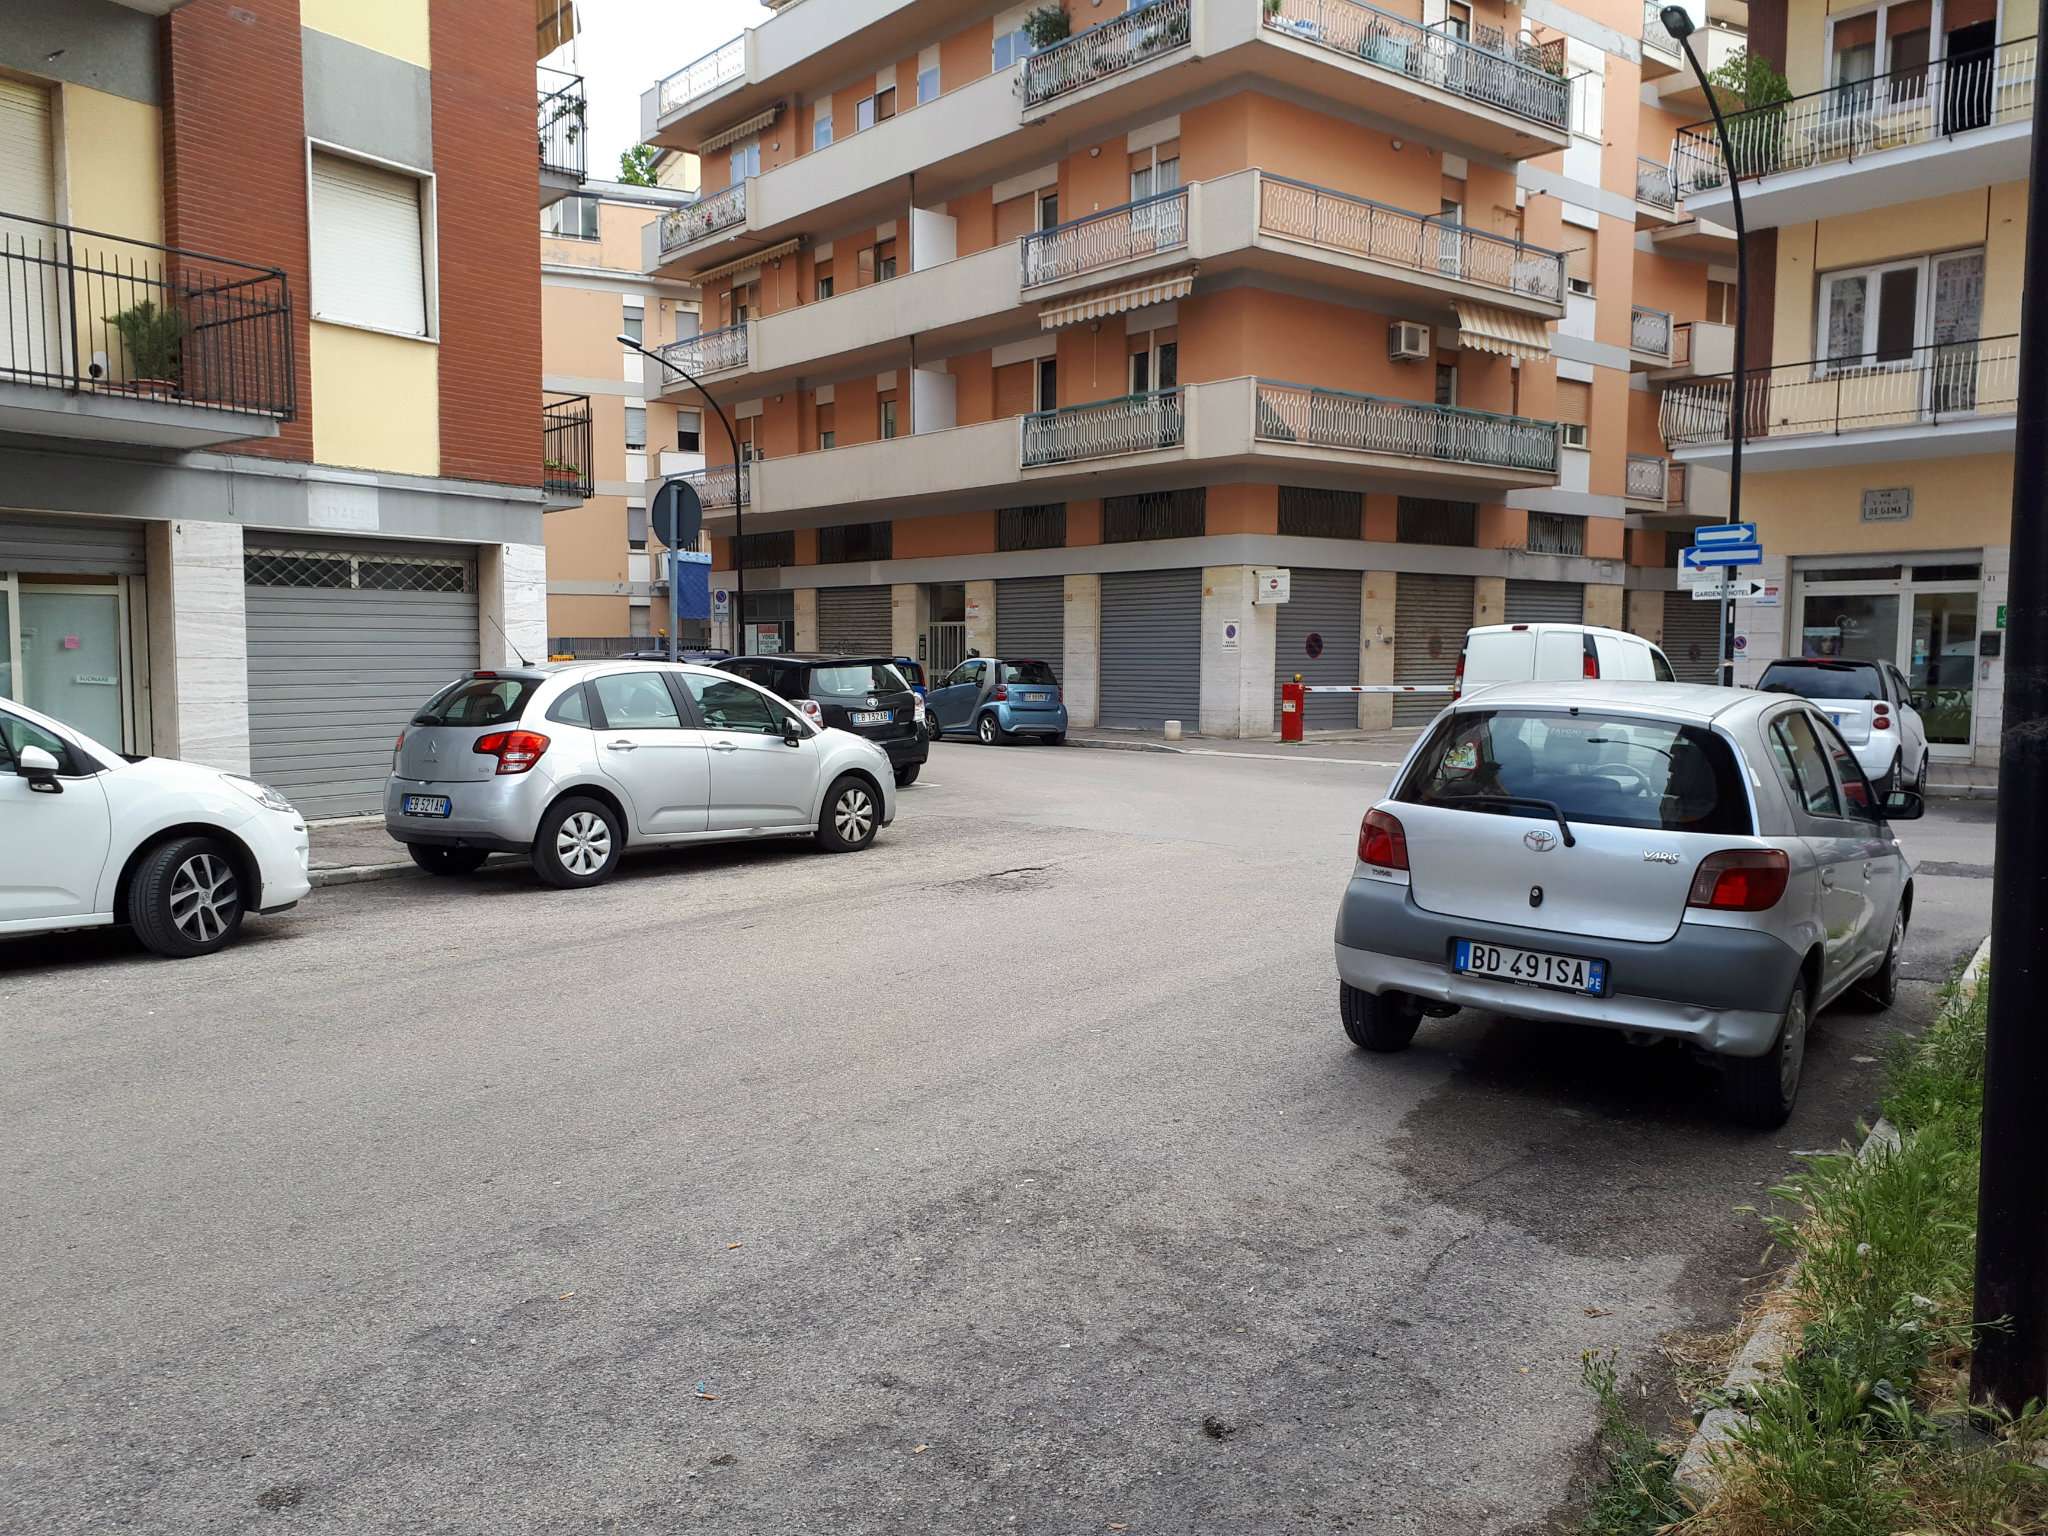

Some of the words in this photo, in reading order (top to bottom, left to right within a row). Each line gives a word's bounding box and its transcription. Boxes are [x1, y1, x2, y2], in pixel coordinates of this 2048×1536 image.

[175, 524, 181, 536] 4
[505, 546, 510, 556] 2
[420, 798, 446, 812] 521AH
[1471, 945, 1500, 972] BD
[1510, 953, 1584, 987] 491SA
